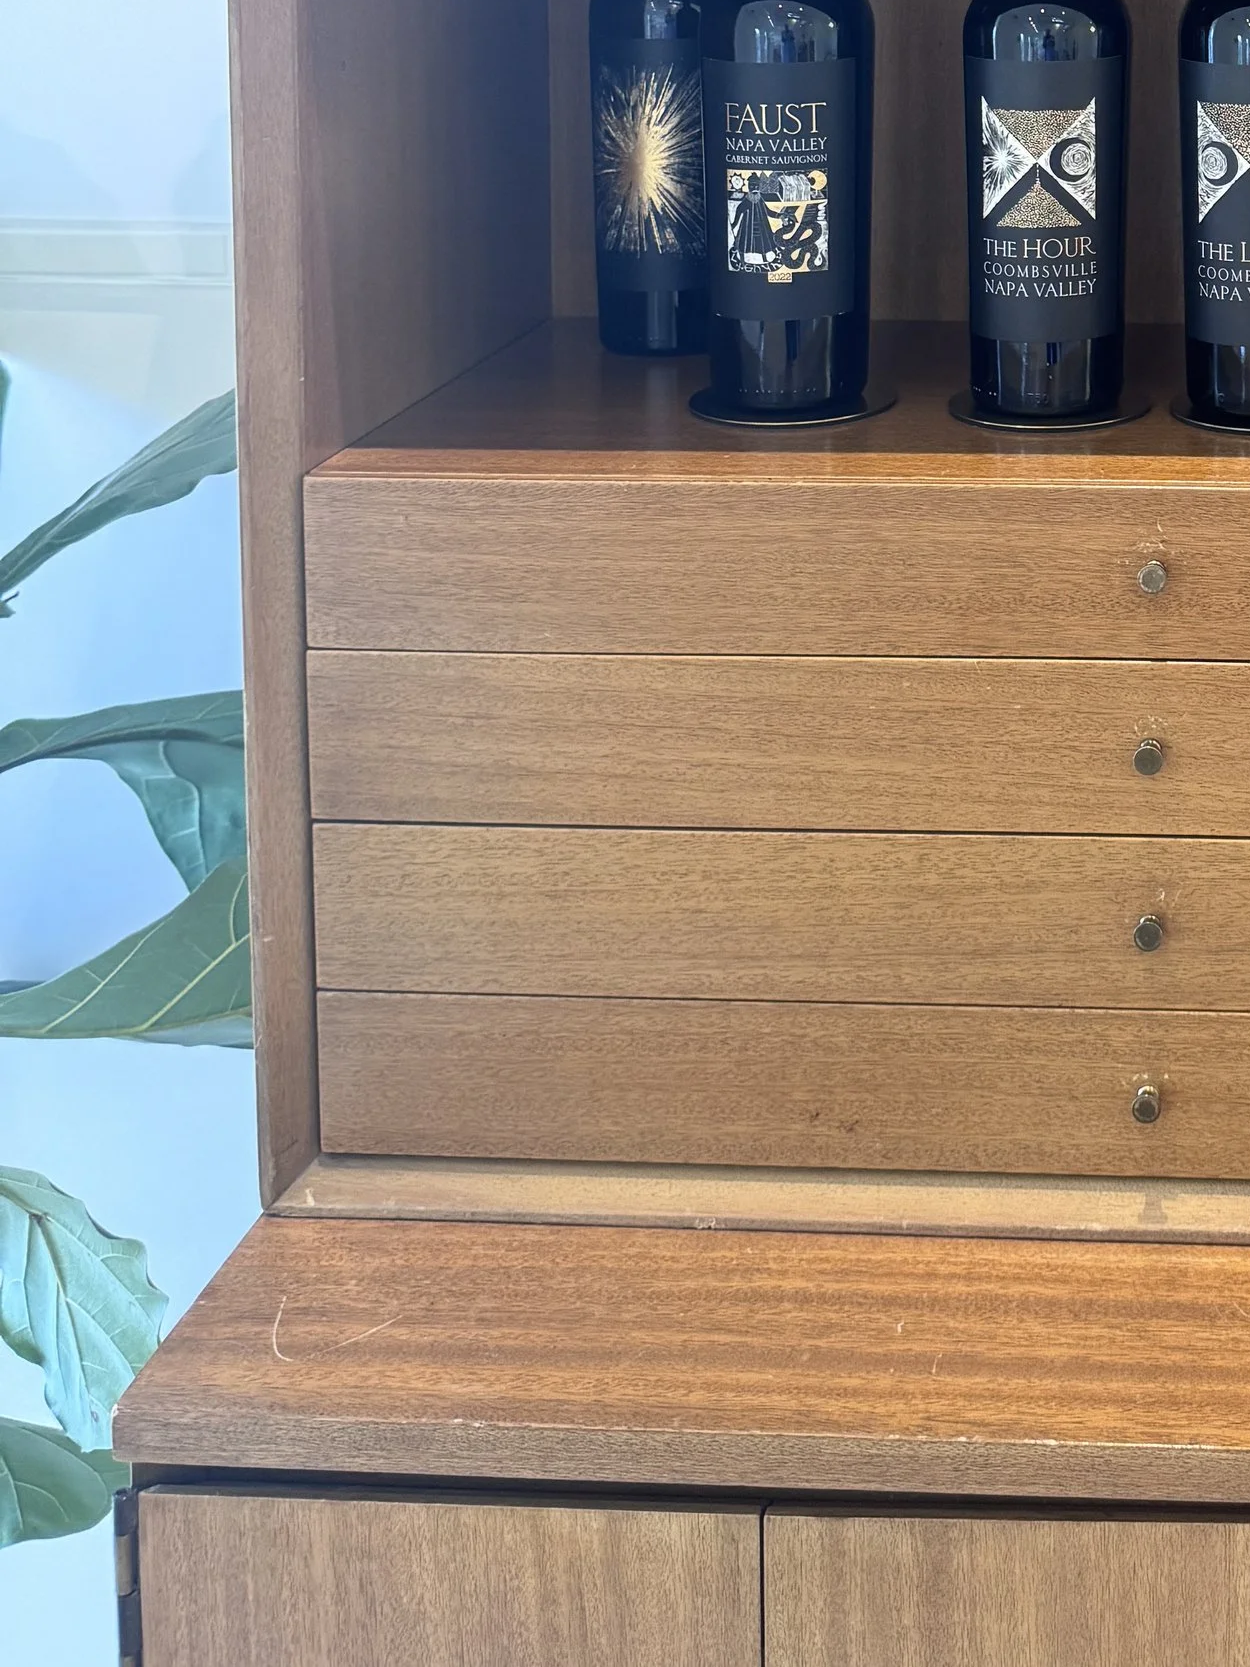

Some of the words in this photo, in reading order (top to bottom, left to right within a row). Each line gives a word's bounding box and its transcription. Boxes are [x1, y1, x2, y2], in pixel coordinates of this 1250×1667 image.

[724, 101, 828, 135] FAUST
[725, 137, 766, 153] NAPA
[769, 136, 828, 153] VALLEY
[725, 153, 771, 166] CABERNET
[771, 153, 828, 166] SAUVIGNON
[983, 237, 1018, 258] THE
[1022, 236, 1098, 259] HOUR
[1197, 239, 1235, 262] THE
[768, 272, 793, 283] 2022
[983, 260, 1098, 279] COOMBSVILLE
[984, 277, 1030, 298] NAPA
[1033, 277, 1098, 298] VALLEY
[1198, 281, 1243, 303] NAPA
